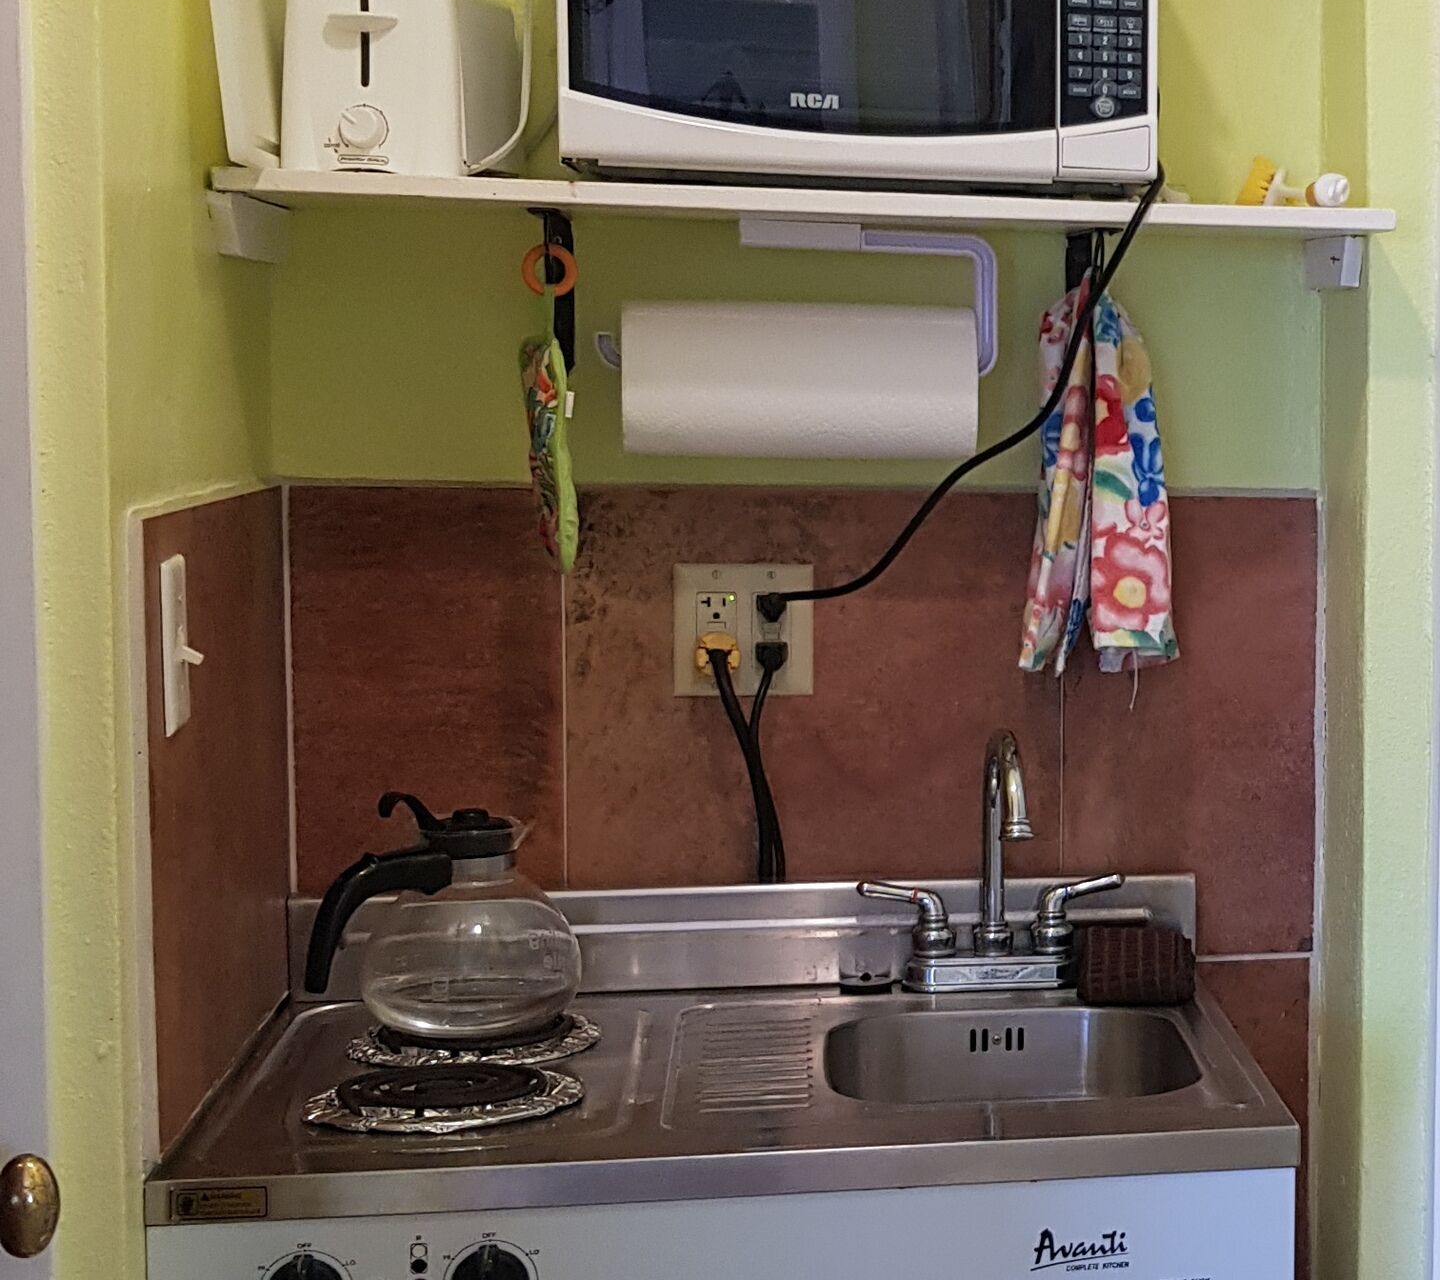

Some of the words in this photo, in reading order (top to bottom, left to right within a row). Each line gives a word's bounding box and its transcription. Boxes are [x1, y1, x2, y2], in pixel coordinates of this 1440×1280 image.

[789, 92, 840, 110] RCA
[1033, 1228, 1128, 1265] Avanti
[1066, 1263, 1100, 1273] COMPLETE
[1102, 1261, 1130, 1270] KITCHEN
